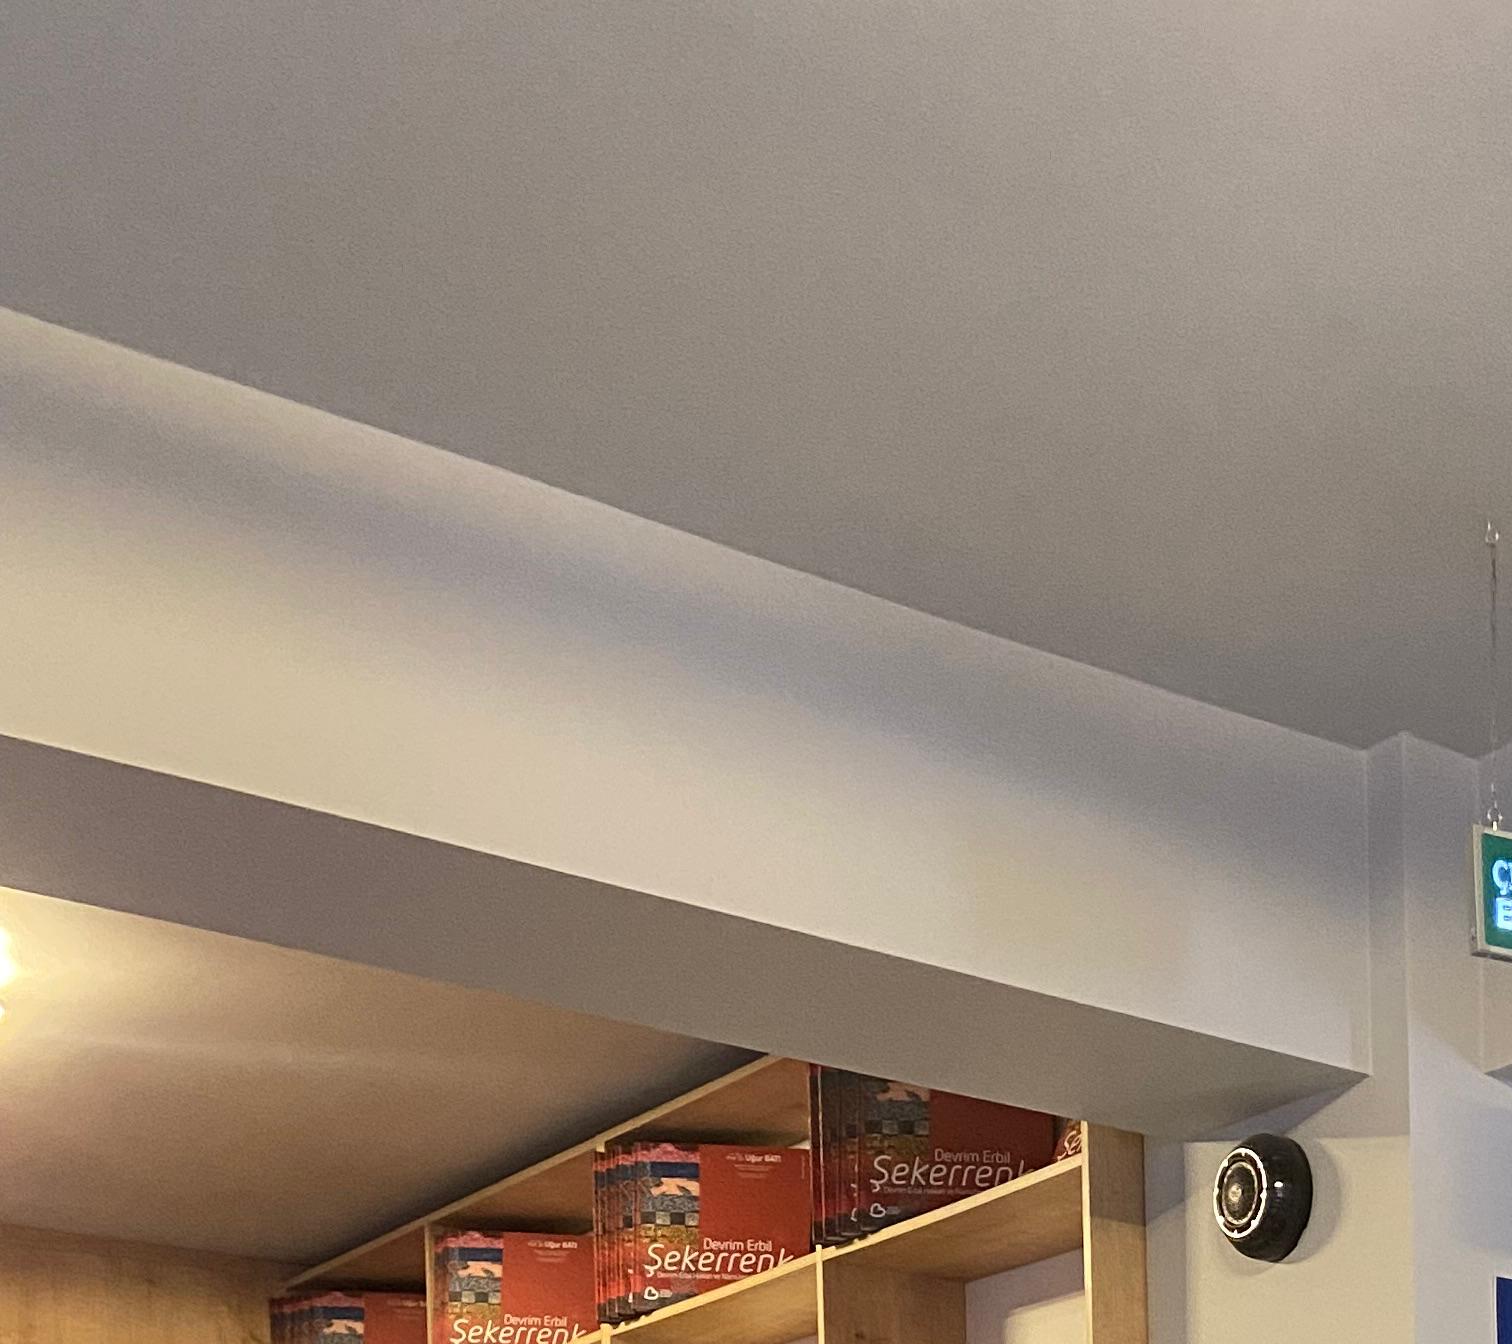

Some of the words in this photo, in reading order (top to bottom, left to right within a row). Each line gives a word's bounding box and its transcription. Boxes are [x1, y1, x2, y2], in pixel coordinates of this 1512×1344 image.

[934, 1148, 980, 1162] Devrim
[983, 1149, 1011, 1163] Erbil
[703, 1237, 744, 1251] Devrim
[747, 1239, 772, 1252] Erbil
[503, 1313, 542, 1326] Devrim
[544, 1315, 568, 1327] Erbil
